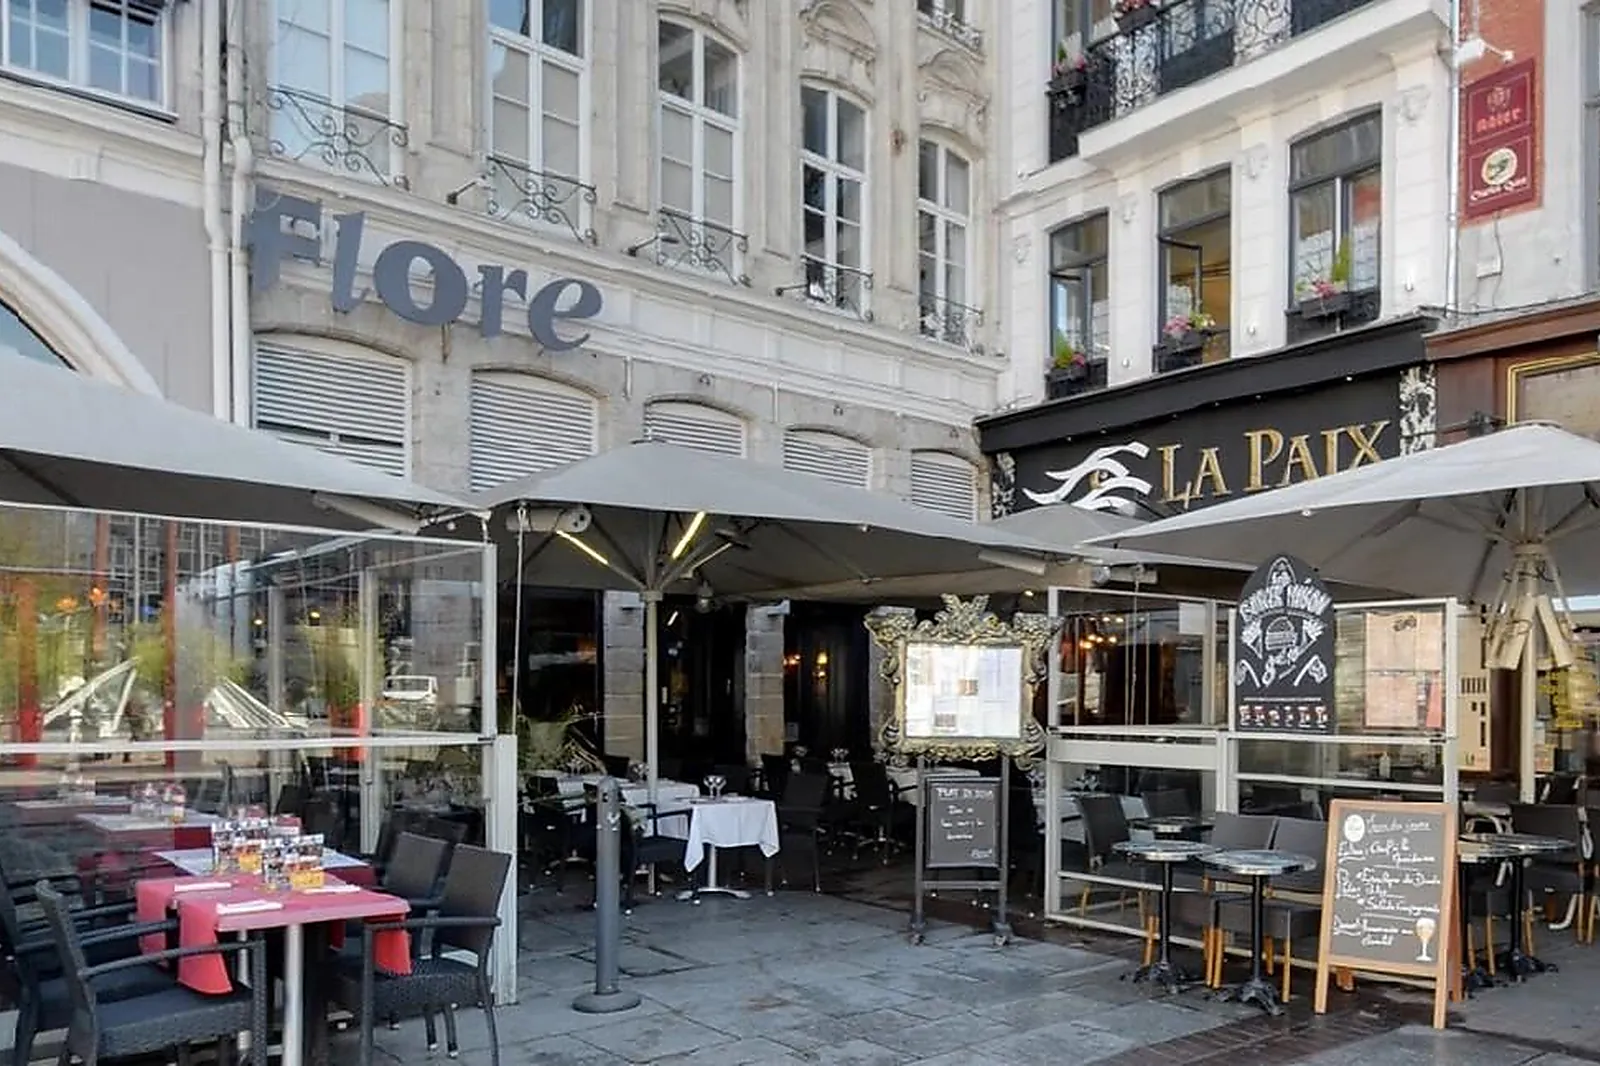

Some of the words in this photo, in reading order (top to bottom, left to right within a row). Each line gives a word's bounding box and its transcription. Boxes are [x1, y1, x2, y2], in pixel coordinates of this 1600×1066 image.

[241, 184, 604, 353] Flore
[1157, 442, 1231, 509] LA
[1242, 420, 1392, 492] PAIX
